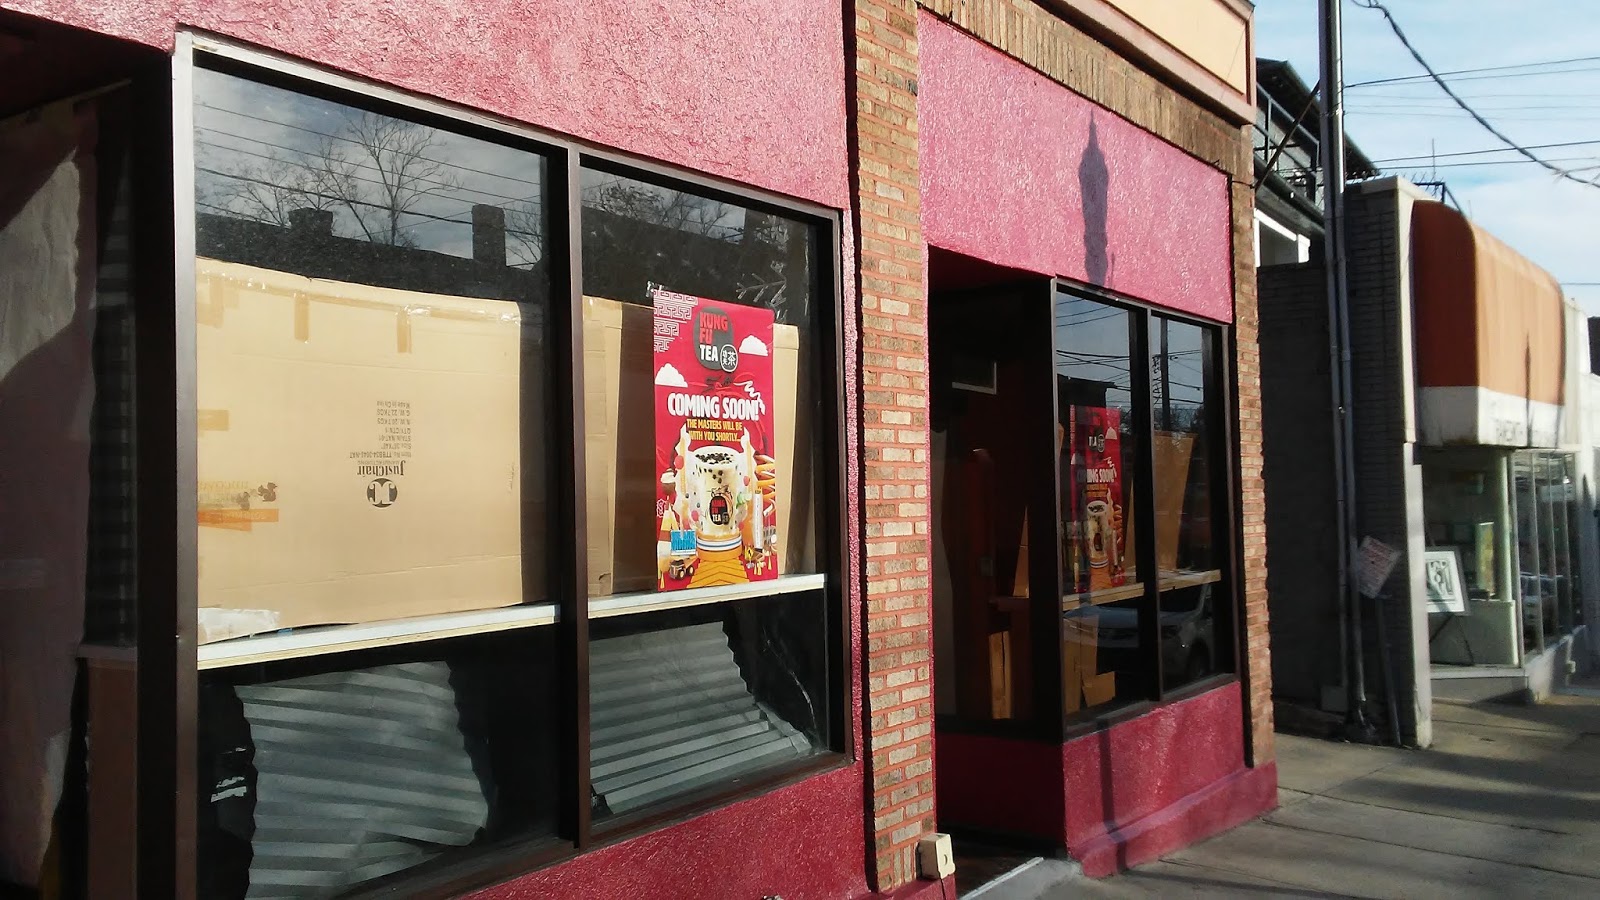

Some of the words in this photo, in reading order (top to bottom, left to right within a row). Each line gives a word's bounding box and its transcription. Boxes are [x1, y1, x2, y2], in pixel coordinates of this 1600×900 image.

[700, 312, 728, 332] KUNG
[700, 328, 712, 344] FU
[700, 344, 718, 362] TEA
[668, 392, 720, 418] COMING
[722, 397, 760, 420] SOON!
[686, 418, 697, 428] THE
[698, 420, 722, 430] MASTERS
[722, 421, 735, 430] WILL
[736, 422, 743, 430] BE
[688, 431, 702, 440] WITH
[704, 431, 715, 441] YOU
[356, 460, 406, 477] JustChair
